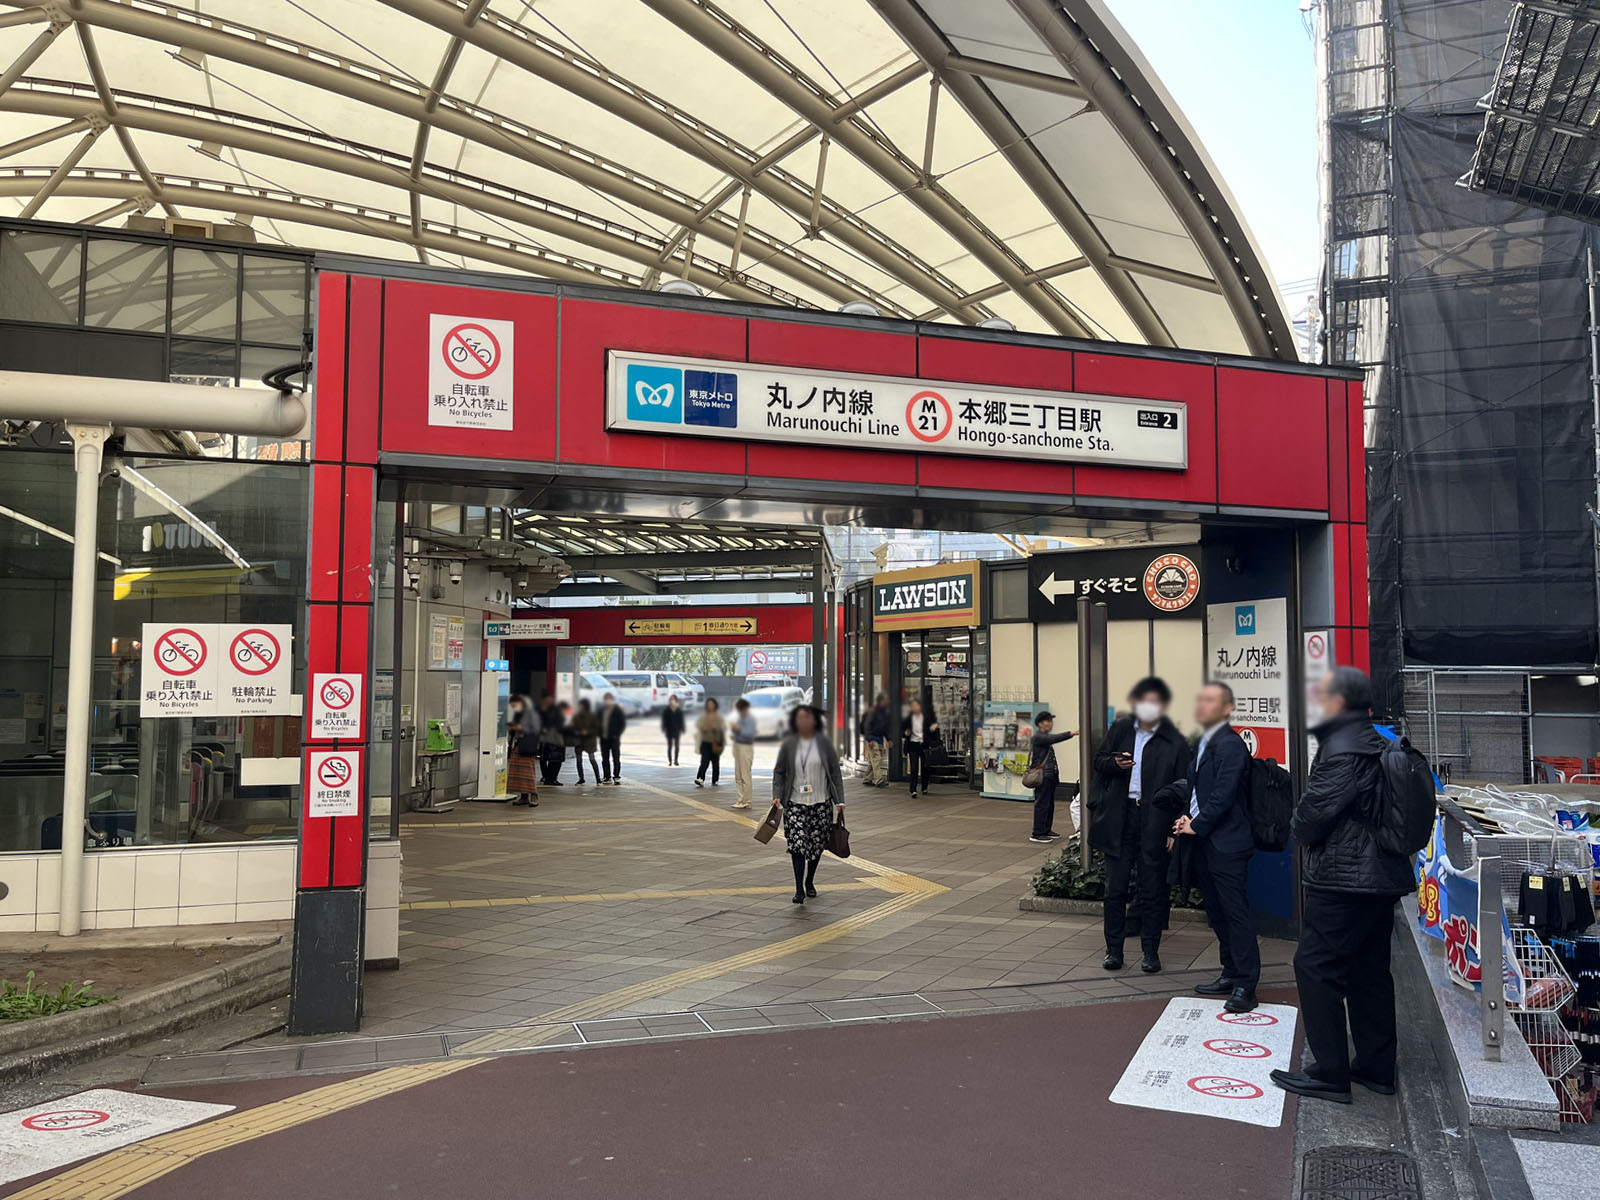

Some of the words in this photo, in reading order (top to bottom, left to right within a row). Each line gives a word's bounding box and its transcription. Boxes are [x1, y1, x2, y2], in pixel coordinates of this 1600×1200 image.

[452, 383, 490, 397] 自転車
[689, 389, 733, 402] 東京メトロ
[433, 394, 509, 411] 乗り入れ禁止
[692, 399, 711, 408] Tokyo
[711, 401, 731, 409] Metro
[766, 381, 874, 416] 丸ノ内線
[921, 399, 937, 413] M
[462, 409, 493, 419] Bicycles
[958, 398, 1102, 433] 本郷三丁目駅
[1163, 413, 1172, 428] 2
[767, 411, 862, 434] Marunouchi
[868, 419, 900, 436] Line
[918, 415, 938, 431] 21
[958, 426, 1083, 450] Hongo-sanchome
[1087, 435, 1115, 452] Sta.
[1146, 557, 1197, 583] CHOCOCRO
[1079, 577, 1138, 595] すぐそこ
[879, 579, 967, 612] LAWSON
[702, 622, 708, 632] 1
[1216, 645, 1277, 668] 丸ノ内線
[1263, 668, 1281, 680] Line
[162, 679, 197, 690] 自転車
[231, 686, 277, 697] 駐輪禁止
[146, 690, 213, 701] 乗り入れ禁止
[171, 701, 199, 709] Bicycles
[1235, 697, 1281, 714] 三丁目駅
[325, 711, 347, 719] 自転車
[1243, 731, 1251, 740] M
[317, 790, 351, 798] 終日禁煙
